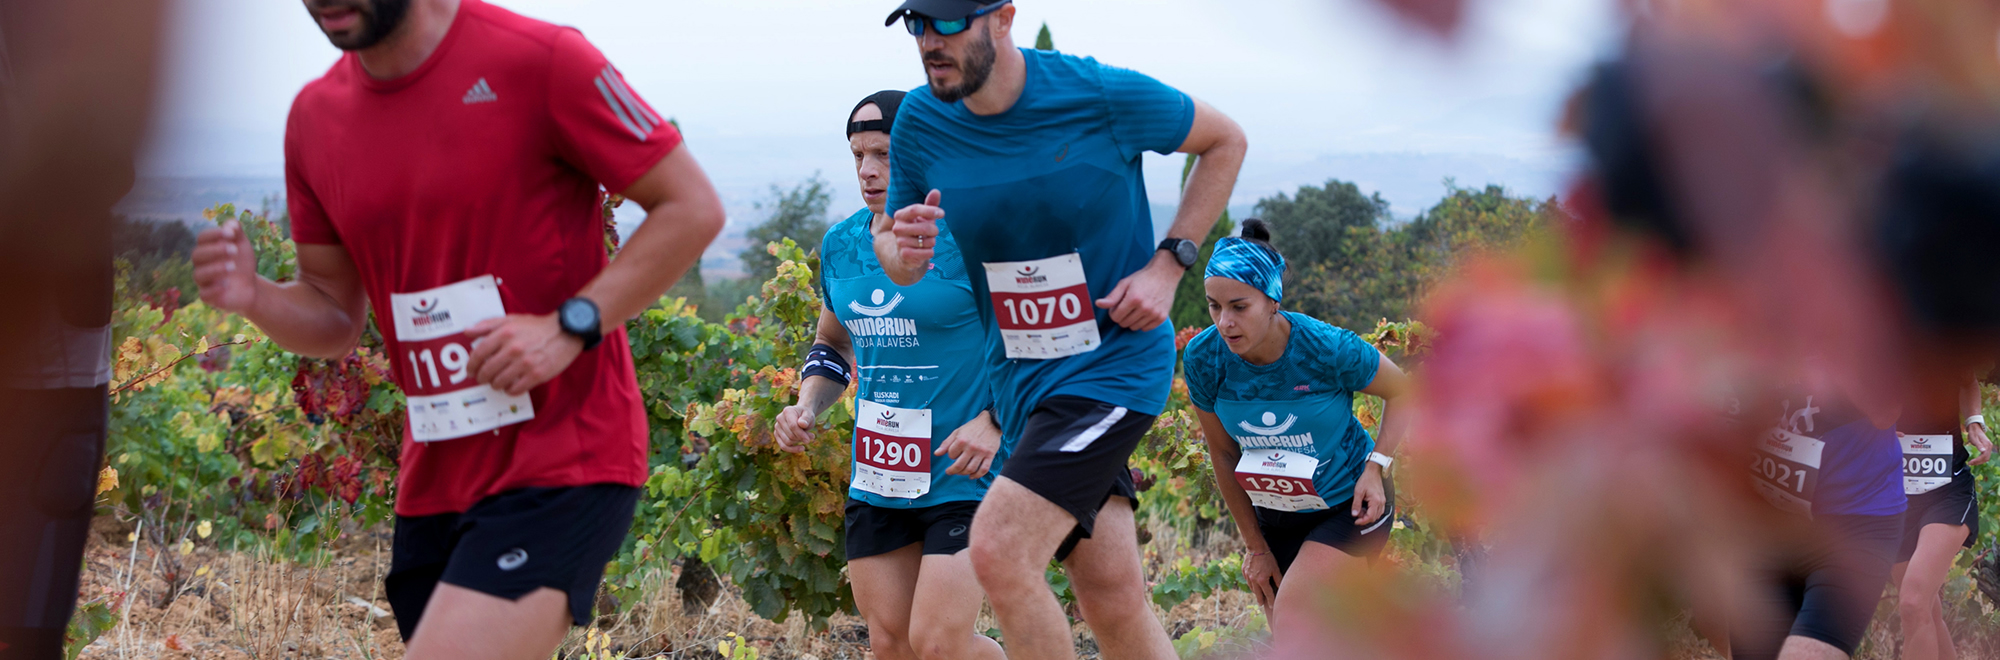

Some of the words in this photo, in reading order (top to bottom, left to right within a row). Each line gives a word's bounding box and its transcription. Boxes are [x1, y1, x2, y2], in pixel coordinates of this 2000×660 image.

[1003, 292, 1082, 325] 1070
[876, 336, 920, 348] ALAVESA
[408, 338, 483, 389] 119
[873, 391, 900, 399] EUSKADI
[862, 435, 922, 468] 1290
[1245, 477, 1309, 493] 1291
[1750, 452, 1807, 493] 2021
